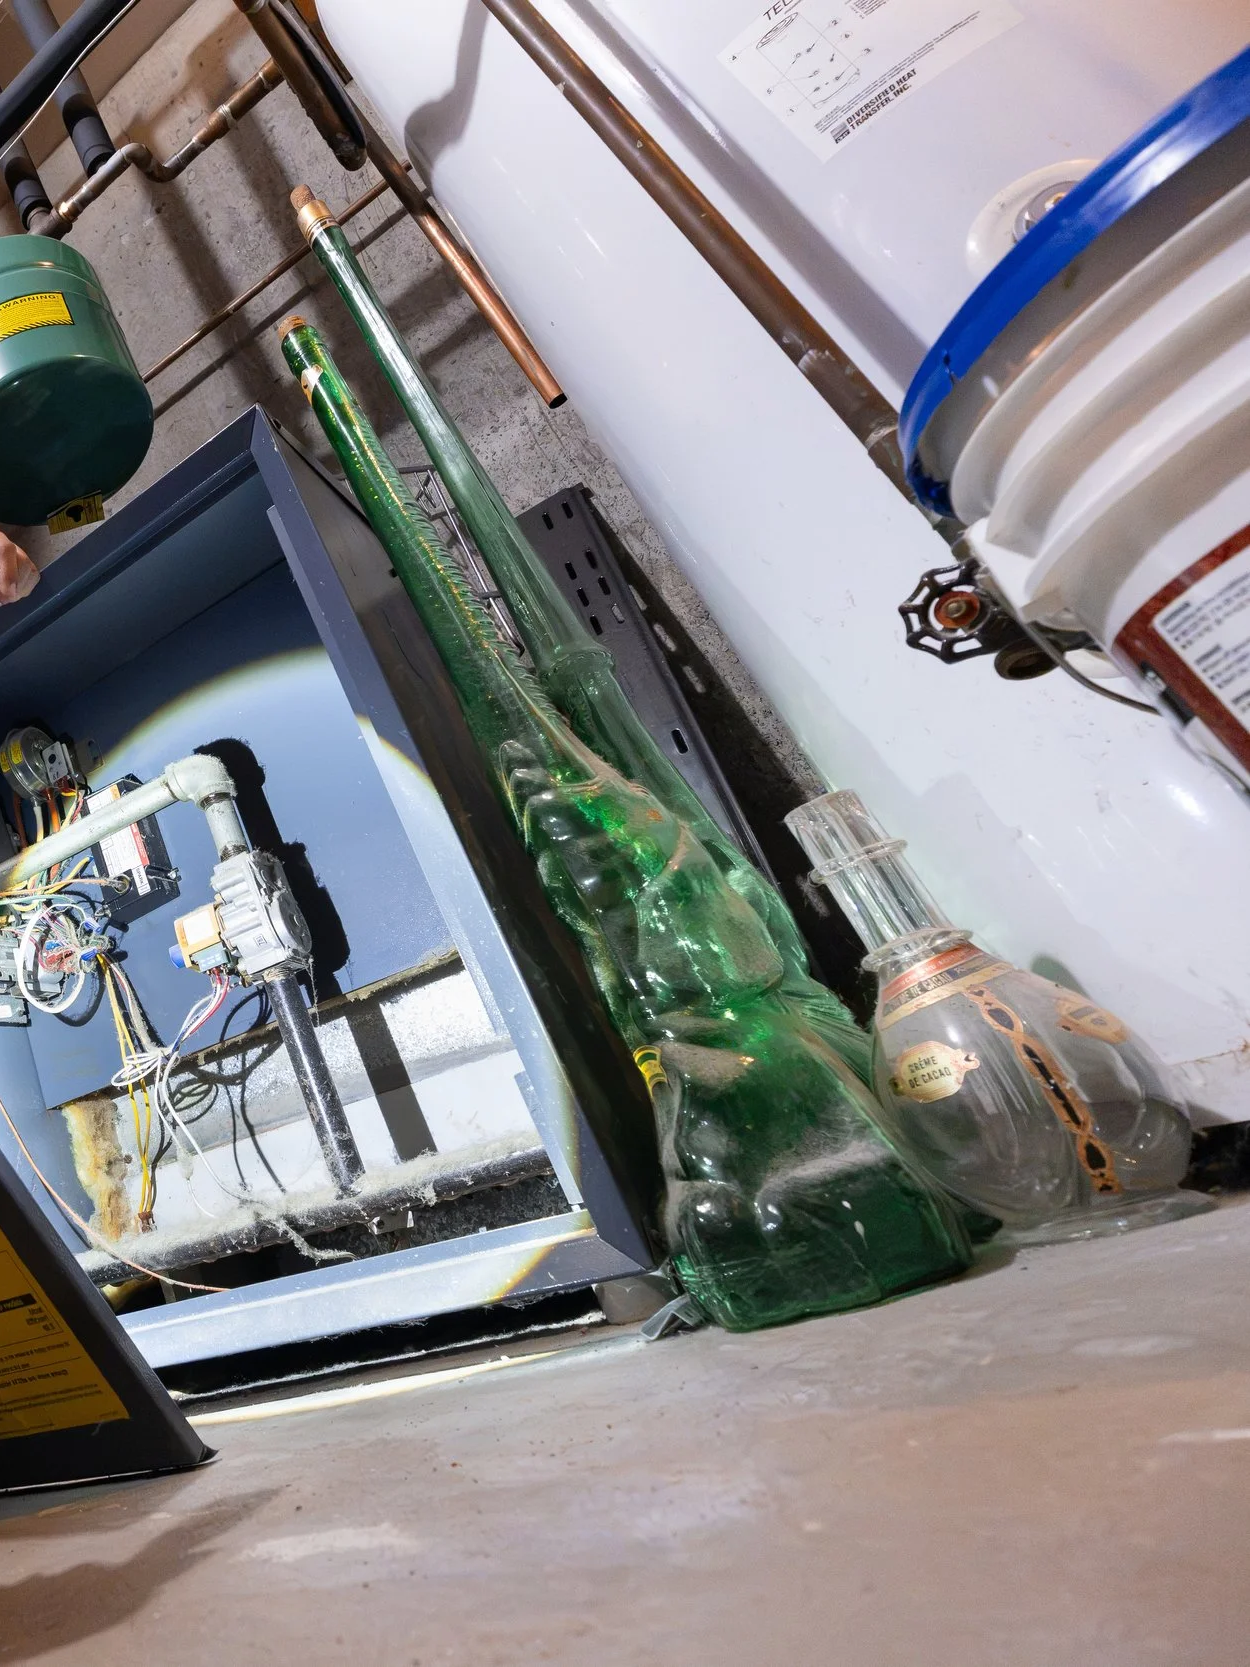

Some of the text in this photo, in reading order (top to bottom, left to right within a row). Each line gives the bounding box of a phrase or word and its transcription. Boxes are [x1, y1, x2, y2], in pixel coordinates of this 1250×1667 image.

[846, 68, 917, 125] DIVERSIFIED HEAT
[893, 83, 912, 98] INC.
[908, 1066, 951, 1089] DE CACAO
